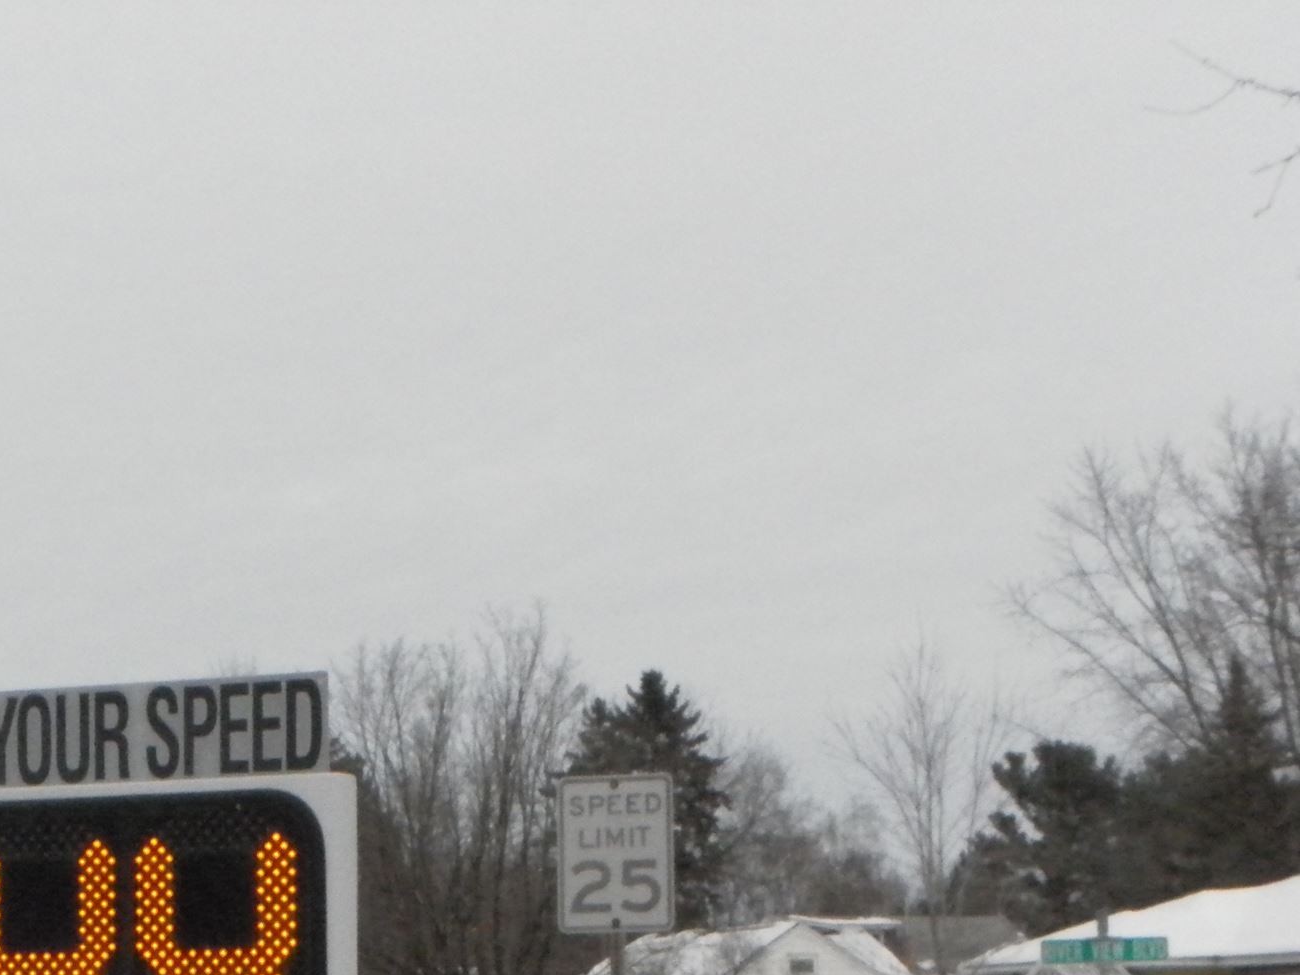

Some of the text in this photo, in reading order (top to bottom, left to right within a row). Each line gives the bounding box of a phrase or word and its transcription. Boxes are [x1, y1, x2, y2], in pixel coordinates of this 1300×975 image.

[146, 678, 323, 781] SPEED
[569, 792, 663, 818] SPEED
[578, 825, 652, 850] LIMIT
[569, 858, 662, 914] 25
